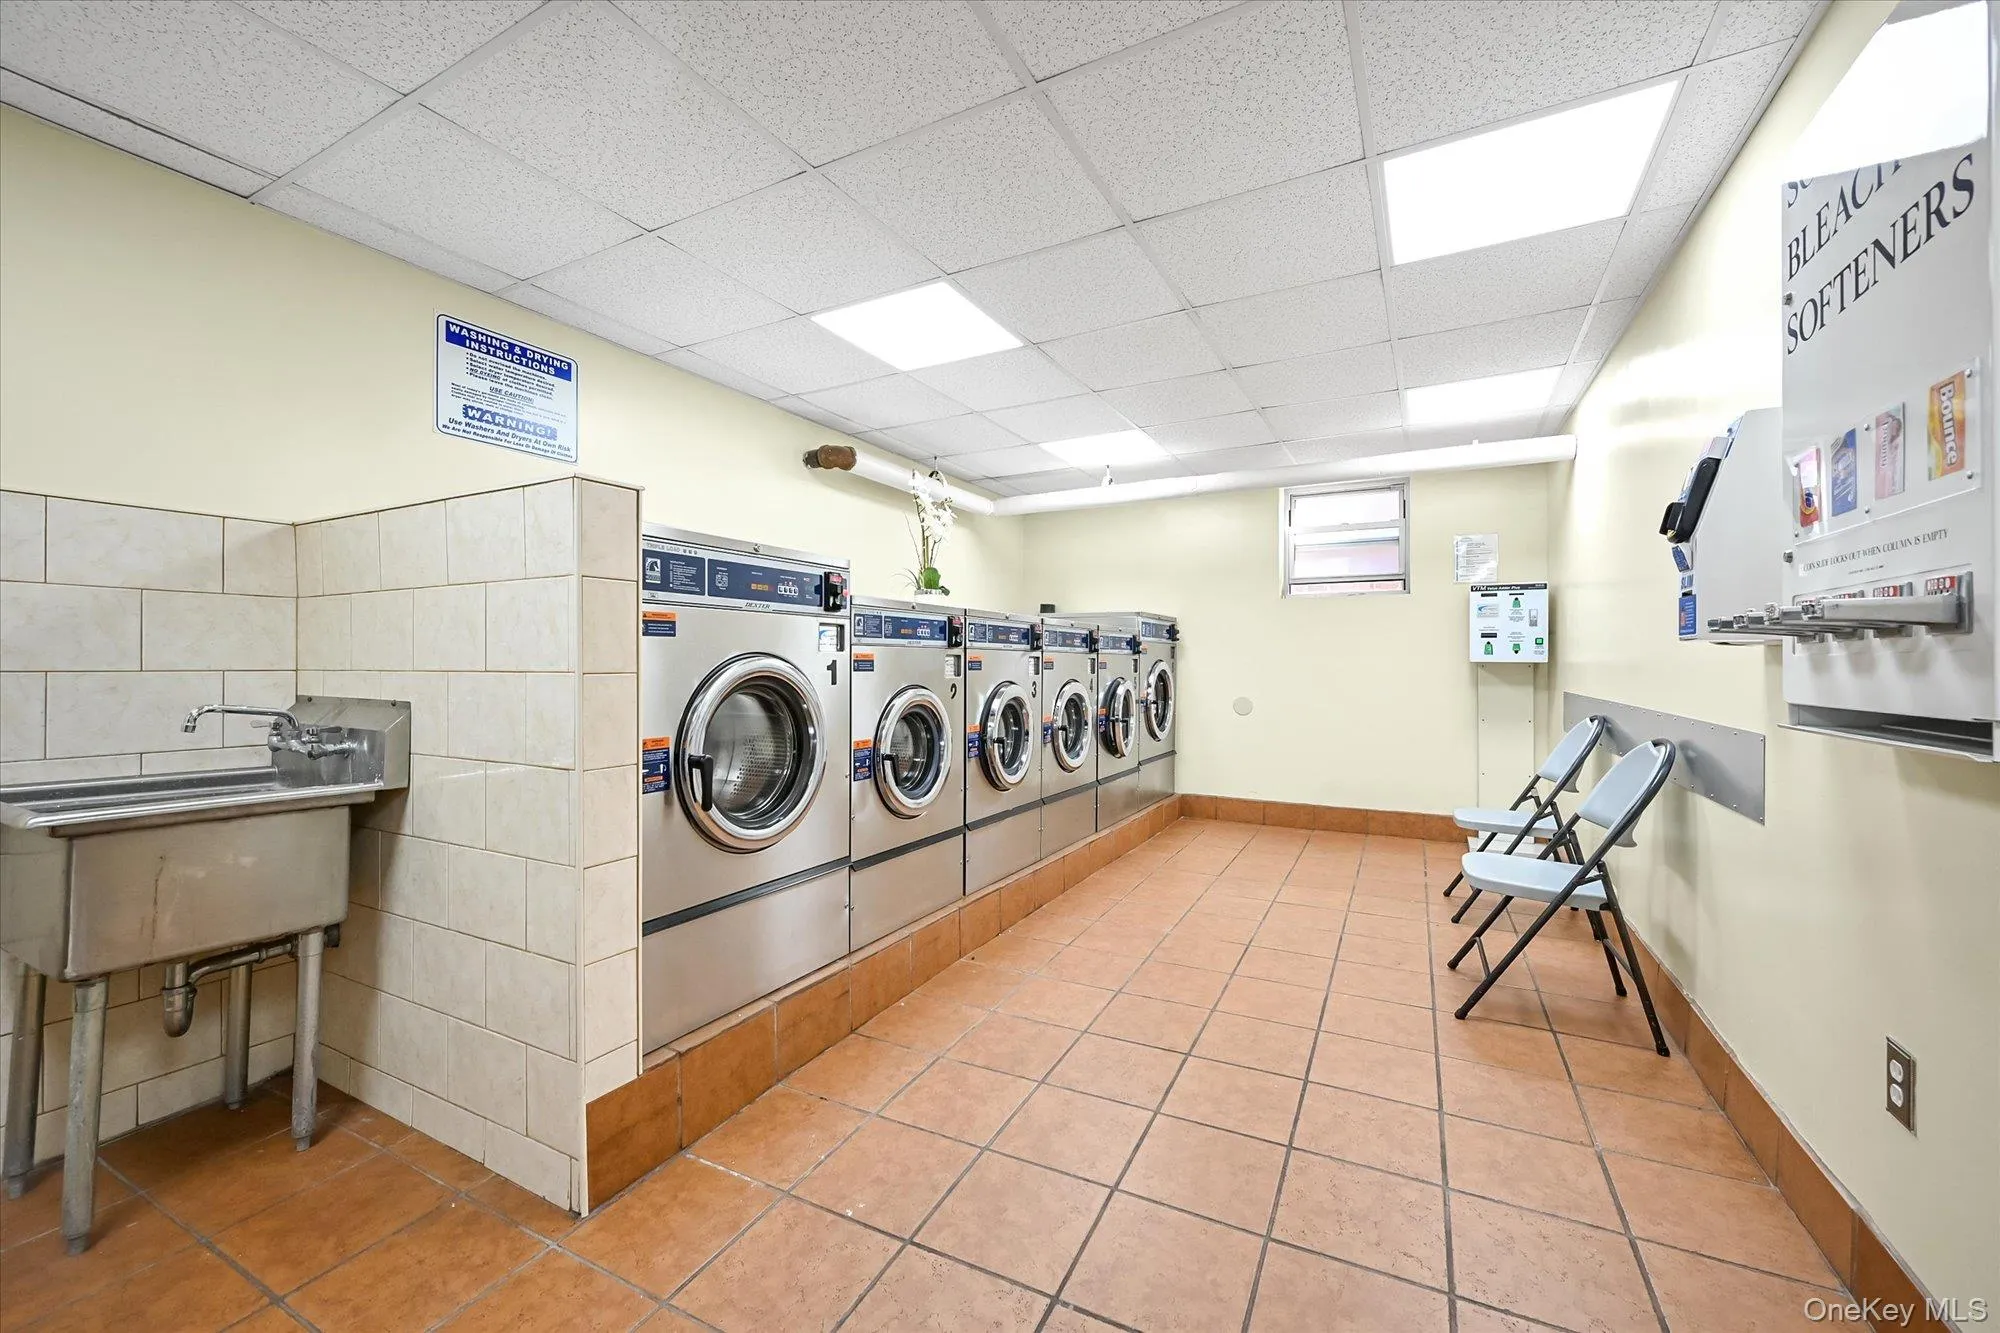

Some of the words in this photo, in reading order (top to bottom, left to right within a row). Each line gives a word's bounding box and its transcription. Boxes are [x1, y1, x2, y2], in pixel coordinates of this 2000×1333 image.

[1787, 153, 1974, 355] SOFTENERS
[449, 323, 509, 350] WASHING
[514, 345, 521, 354] &
[527, 350, 568, 370] DRYING
[466, 339, 555, 374] INSTRUCTIONS
[490, 386, 502, 395] USE
[448, 417, 462, 426] Use
[465, 421, 494, 434] Washers
[496, 429, 510, 437] And
[511, 432, 532, 443] Dryers
[543, 440, 556, 449] Own
[558, 444, 570, 452] Risk
[468, 408, 551, 437] WARNING!
[473, 431, 503, 442] Responsible
[1939, 380, 1958, 466] Bounce
[1830, 553, 1848, 566] LOCKS
[1848, 550, 1862, 561] OUT
[1862, 545, 1882, 558] WHEN
[1882, 538, 1912, 552] COLUMN
[1914, 536, 1920, 545] IS
[1922, 528, 1948, 544] EMPTY
[826, 660, 837, 686] 1
[1031, 681, 1037, 698] 3
